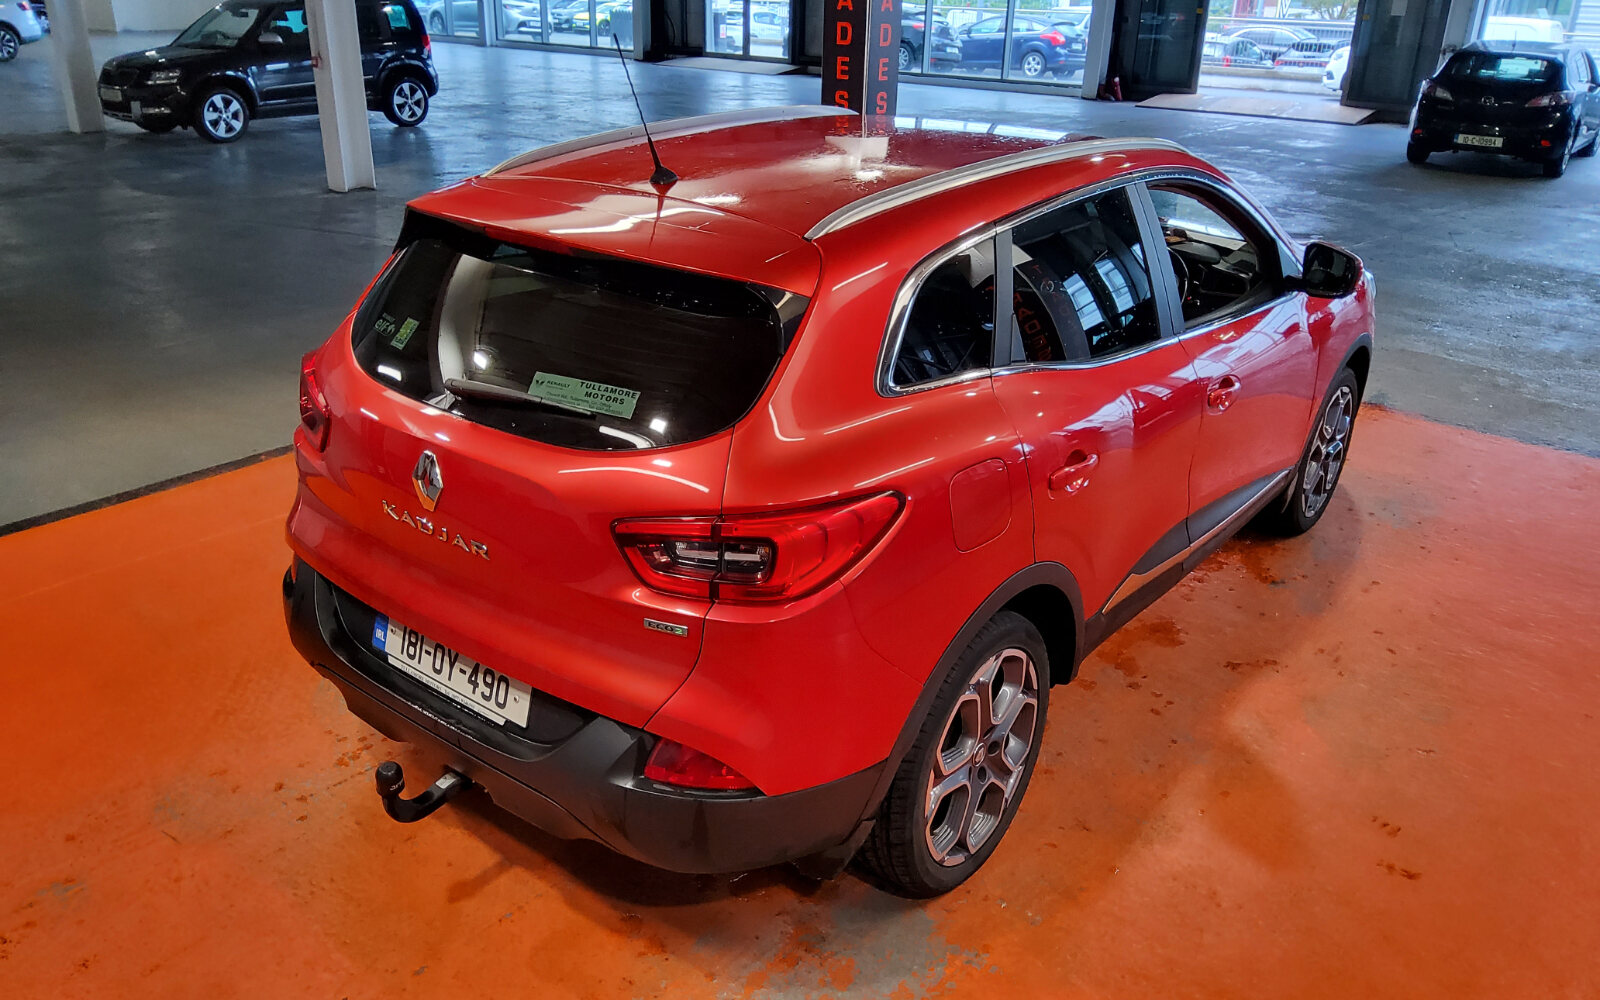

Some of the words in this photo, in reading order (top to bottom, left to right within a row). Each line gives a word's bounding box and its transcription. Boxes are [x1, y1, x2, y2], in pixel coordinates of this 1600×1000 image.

[580, 381, 638, 399] TULLAMORE
[584, 391, 625, 405] MOTORS
[382, 500, 490, 560] KADJAR
[376, 627, 385, 641] IRL
[401, 626, 510, 710] 181-OY-490
